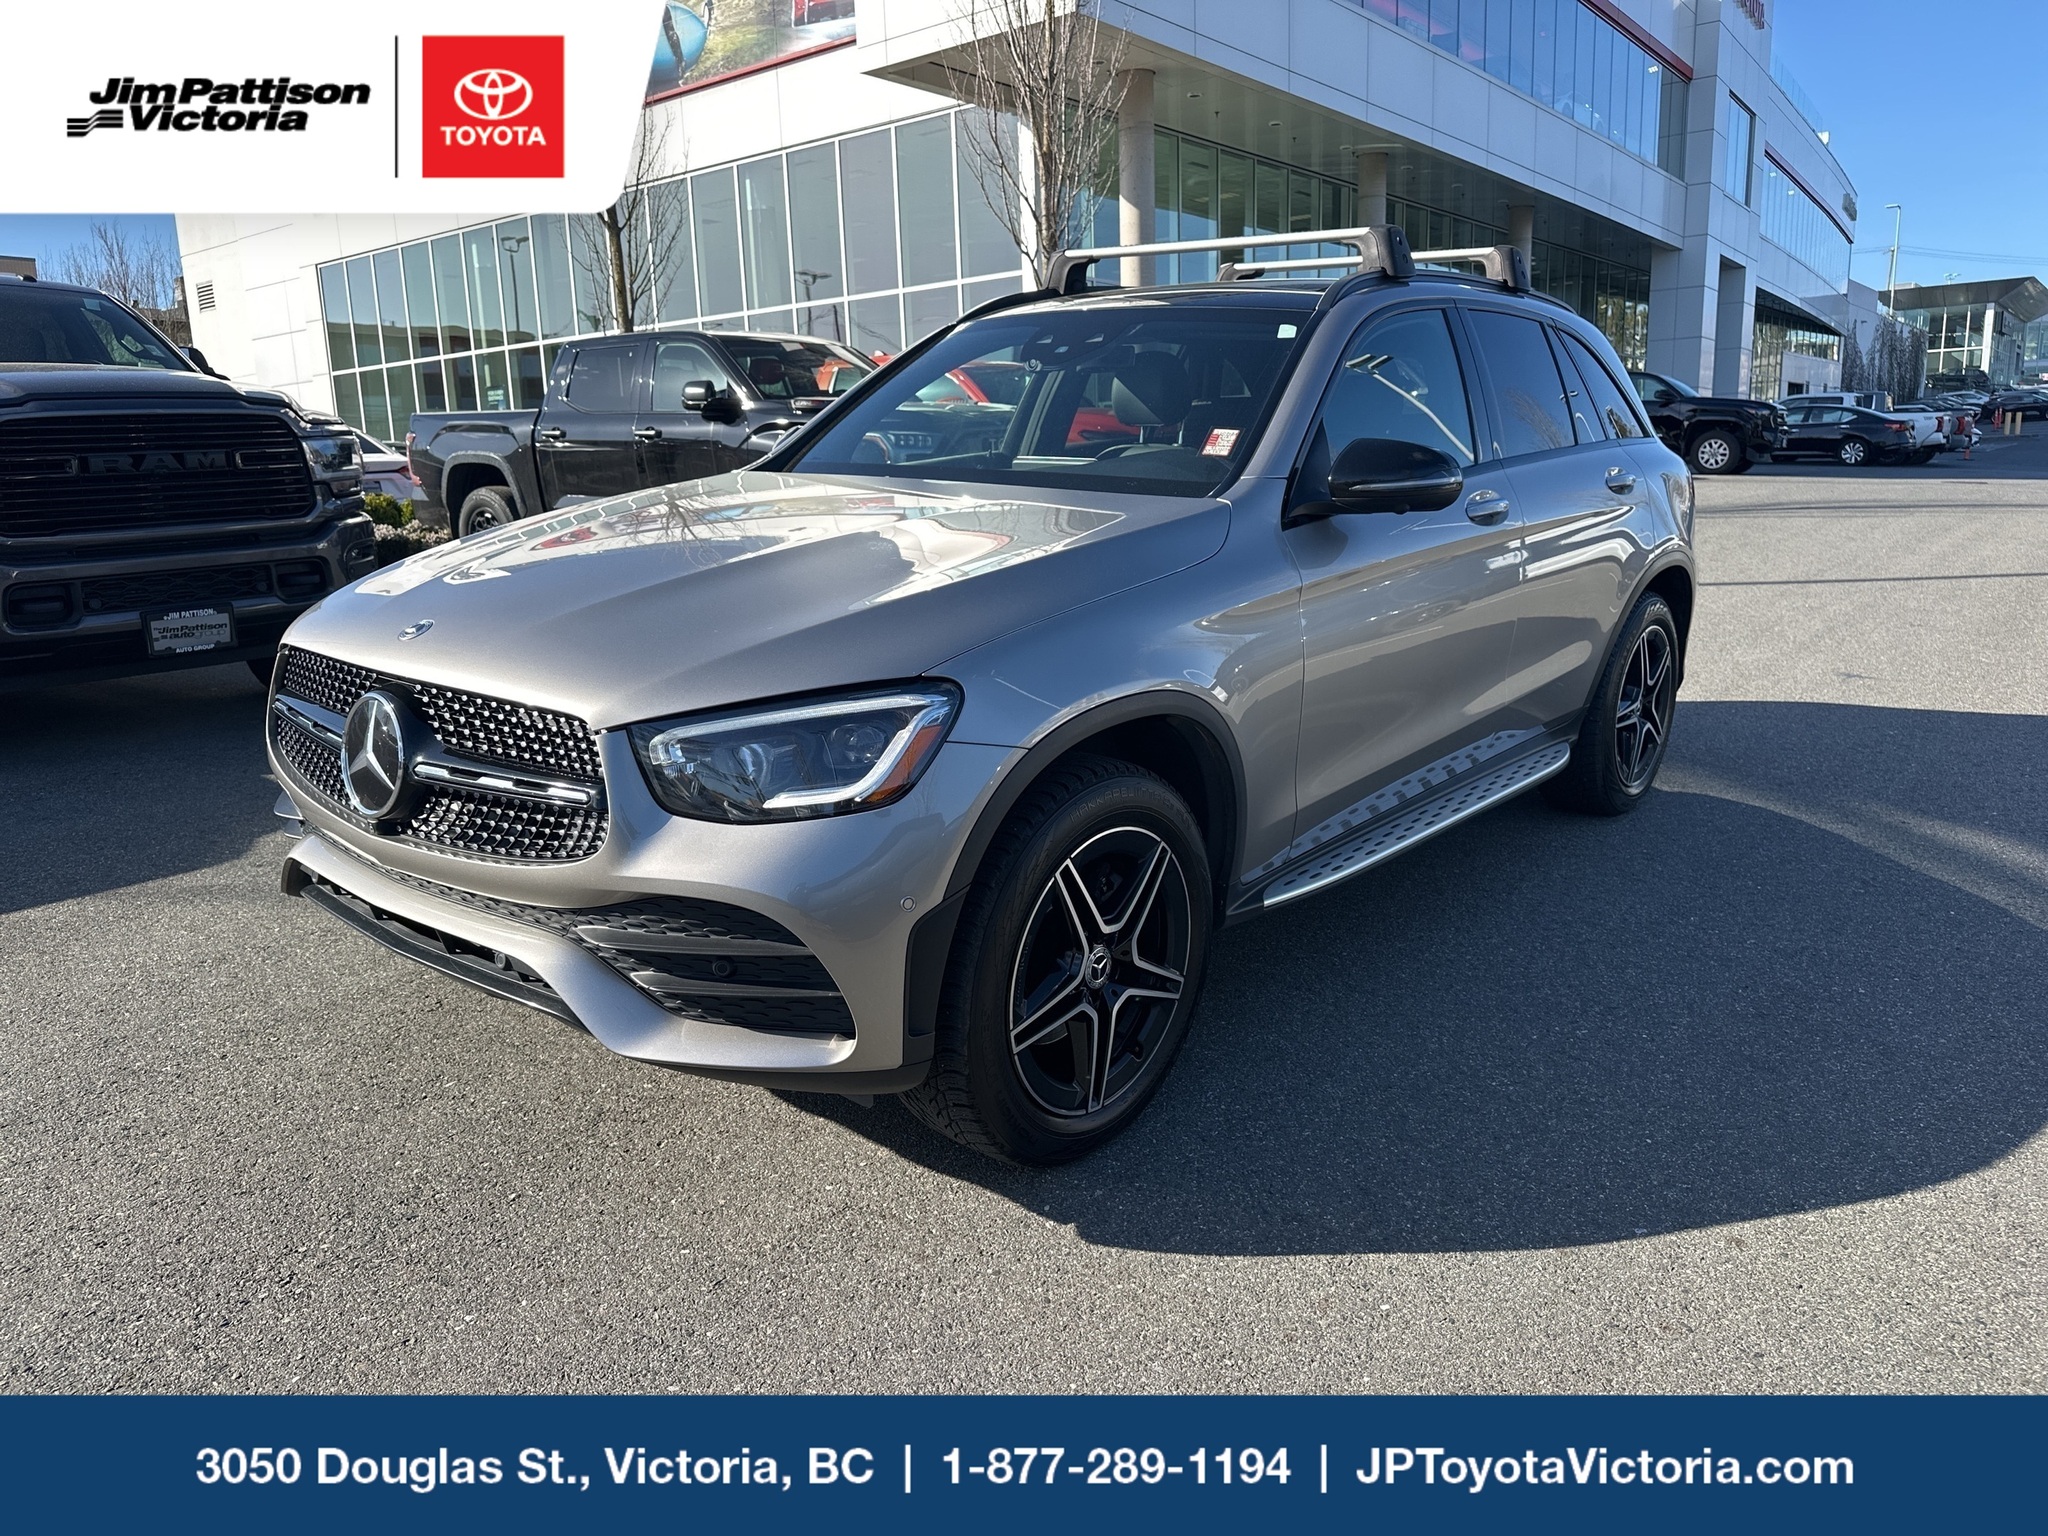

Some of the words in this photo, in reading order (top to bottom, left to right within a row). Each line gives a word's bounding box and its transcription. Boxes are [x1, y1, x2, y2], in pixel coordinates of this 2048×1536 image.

[88, 451, 227, 475] RAM
[167, 611, 180, 620] JIM
[181, 608, 214, 619] PATTISON
[194, 644, 215, 652] GROUP
